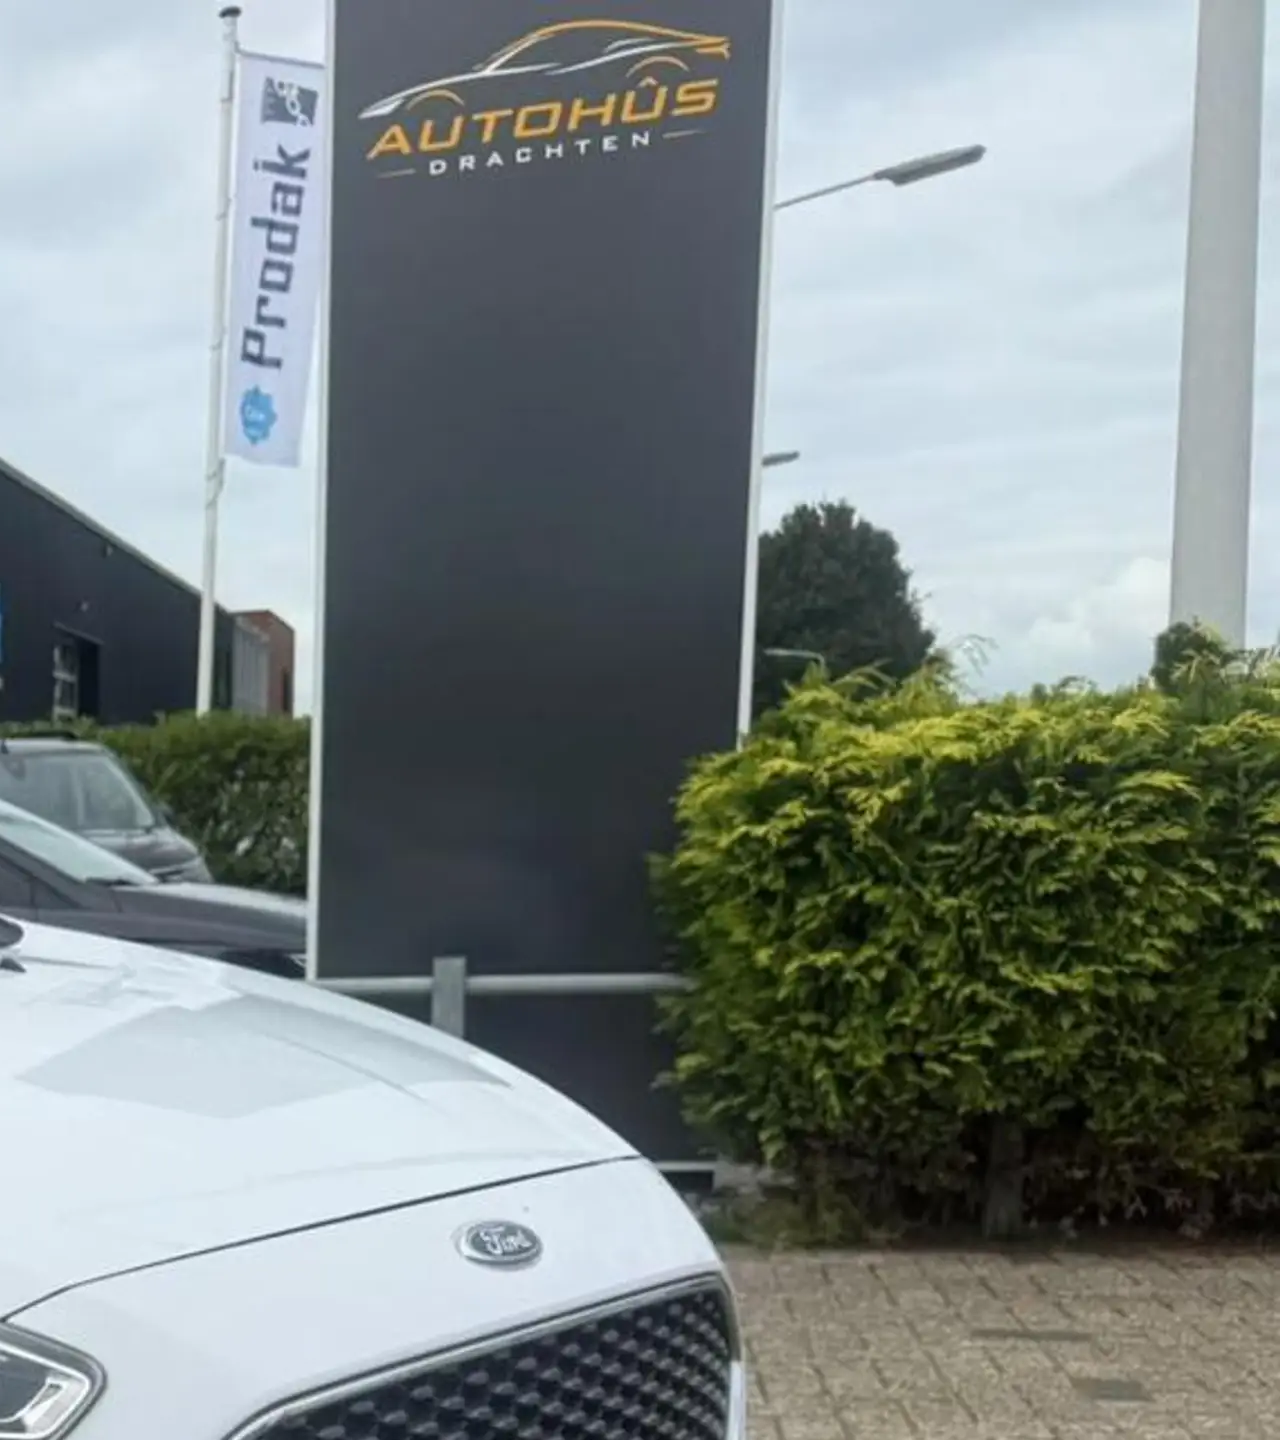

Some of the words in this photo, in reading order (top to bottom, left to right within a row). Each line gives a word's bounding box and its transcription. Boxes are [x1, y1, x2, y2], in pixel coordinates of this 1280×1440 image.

[366, 77, 719, 160] AUTOHÛS
[428, 130, 651, 176] DRACHTEN
[240, 143, 311, 371] Prodak
